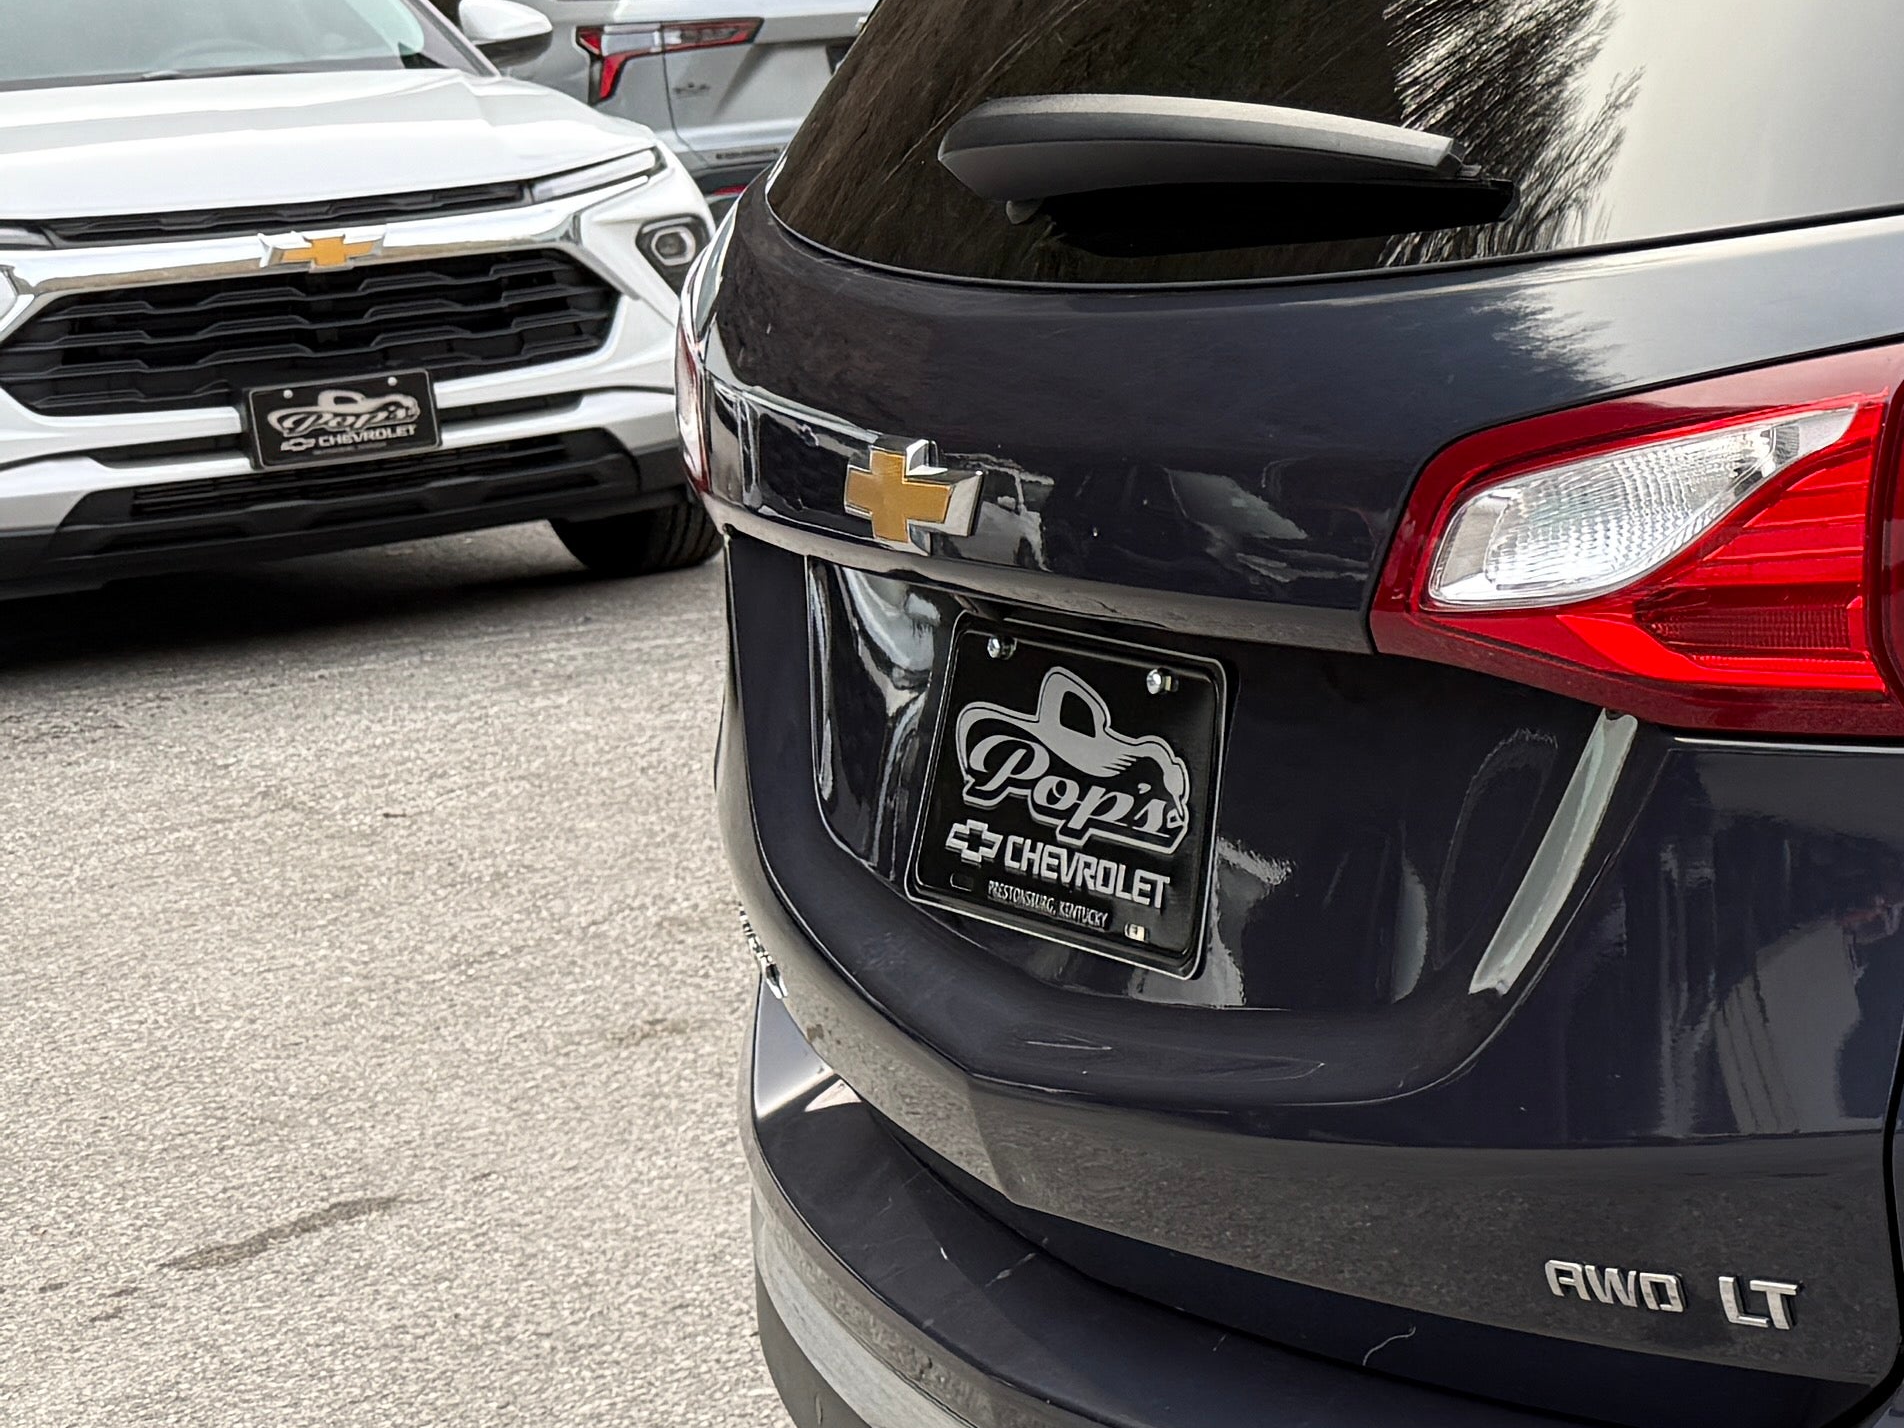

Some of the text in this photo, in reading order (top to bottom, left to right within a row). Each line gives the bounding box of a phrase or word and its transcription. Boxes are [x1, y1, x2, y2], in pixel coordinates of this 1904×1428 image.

[318, 424, 416, 447] CHEVROLET
[969, 734, 1172, 838] Pop's
[1004, 835, 1171, 909] CHEVROLET
[1059, 899, 1109, 929] KENTUCKY
[1544, 1259, 1799, 1330] AWD LT
